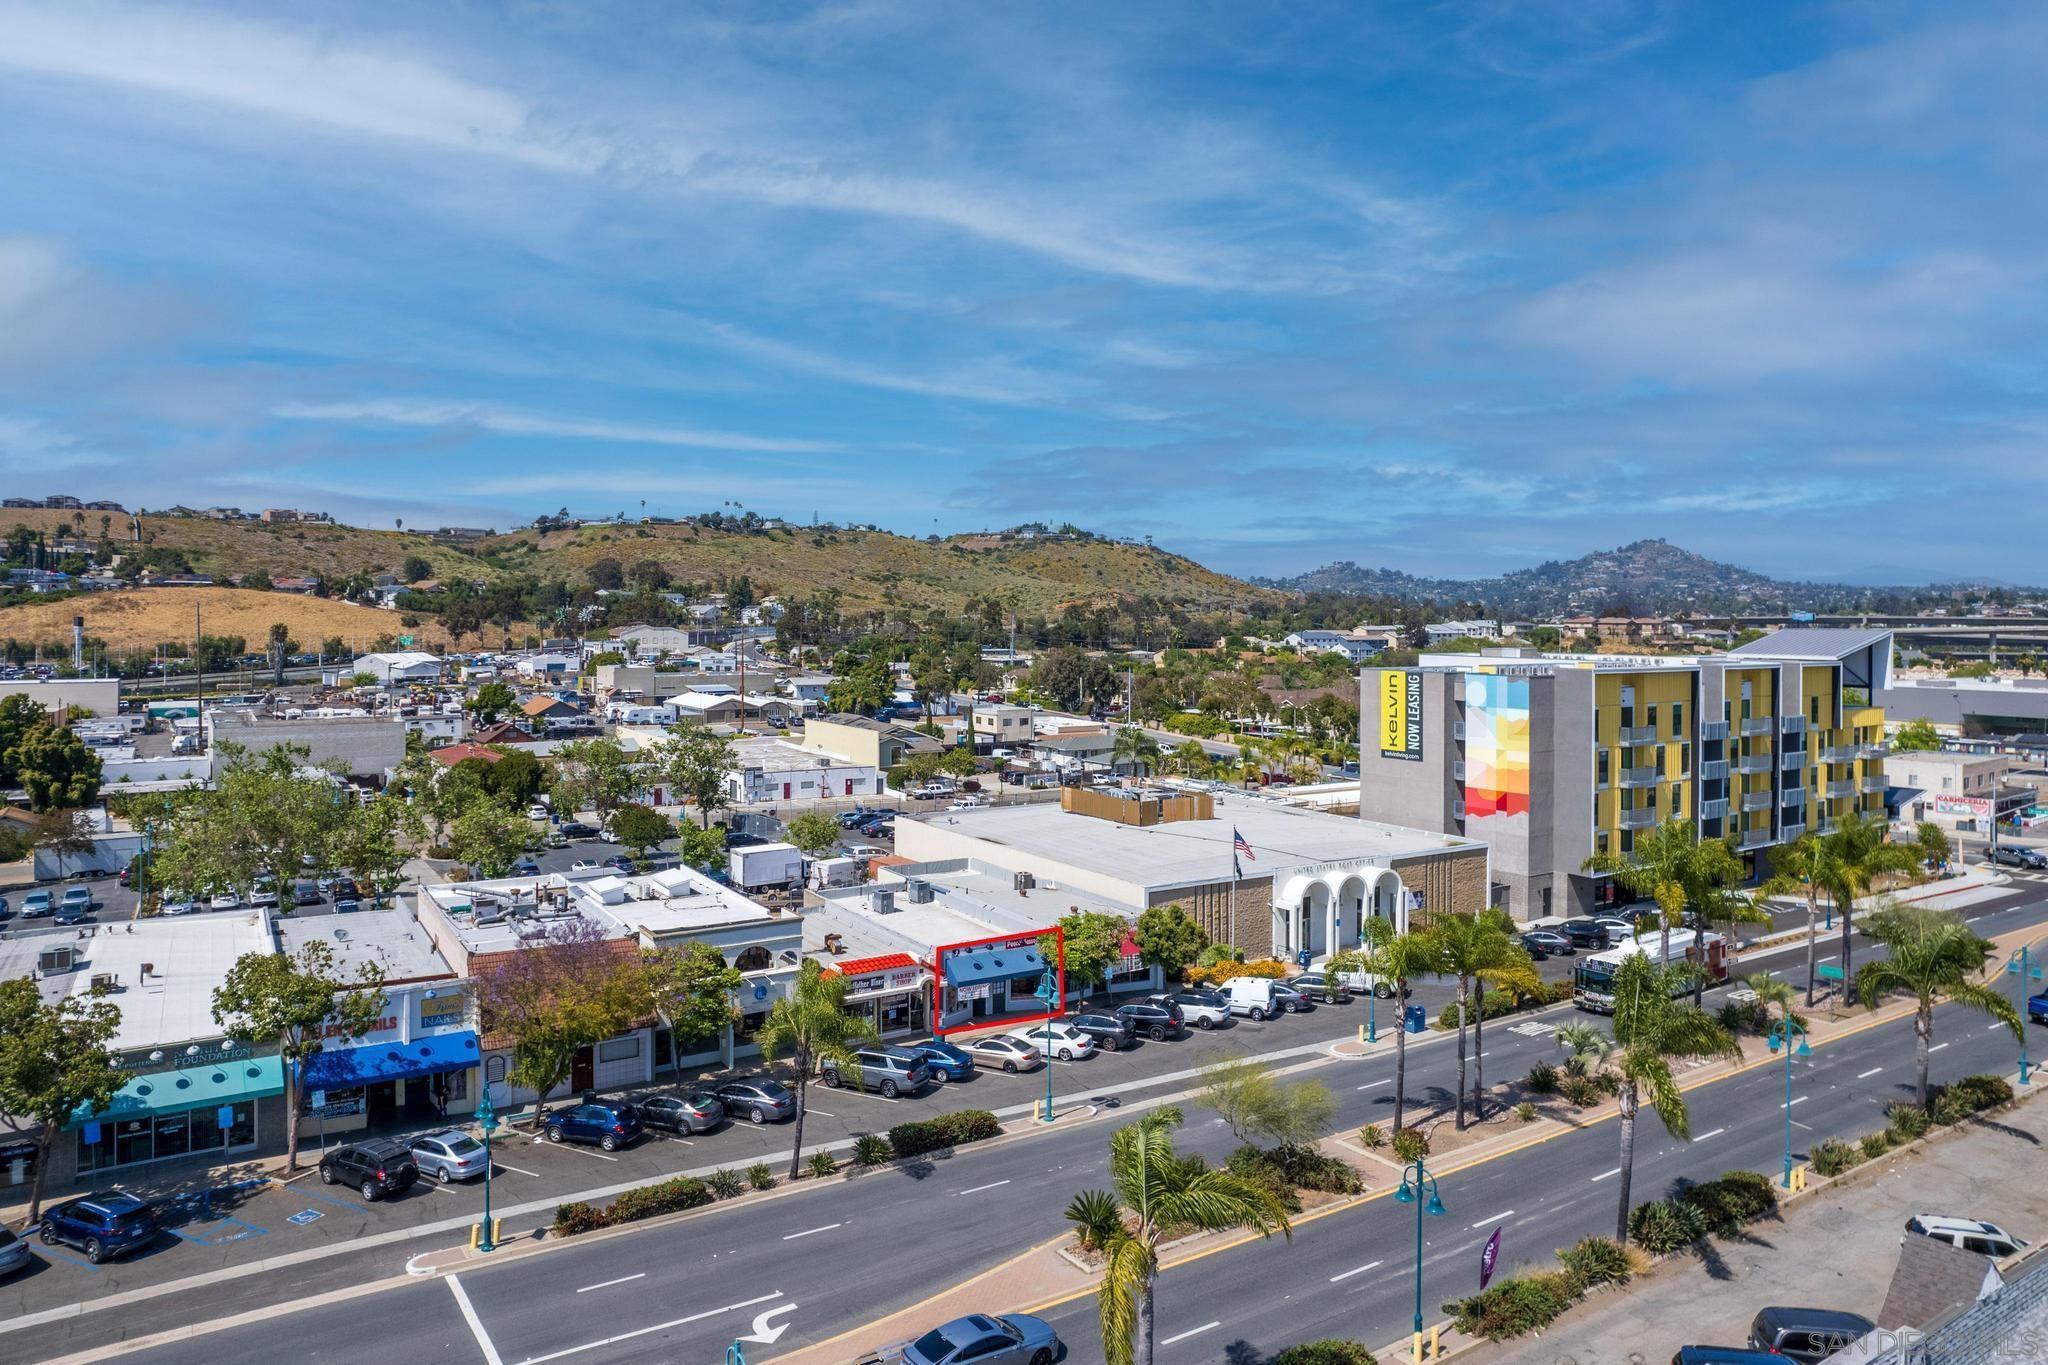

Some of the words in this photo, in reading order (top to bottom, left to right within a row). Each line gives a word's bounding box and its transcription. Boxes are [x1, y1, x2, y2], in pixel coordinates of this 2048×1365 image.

[1407, 674, 1420, 721] LEASING
[1407, 723, 1420, 750] NOW
[1293, 866, 1314, 875] UNITED
[1316, 863, 1336, 873] STATES
[1338, 861, 1352, 870] POST
[1354, 858, 1375, 868] OFFICE
[174, 1048, 251, 1066] FOUNDATION
